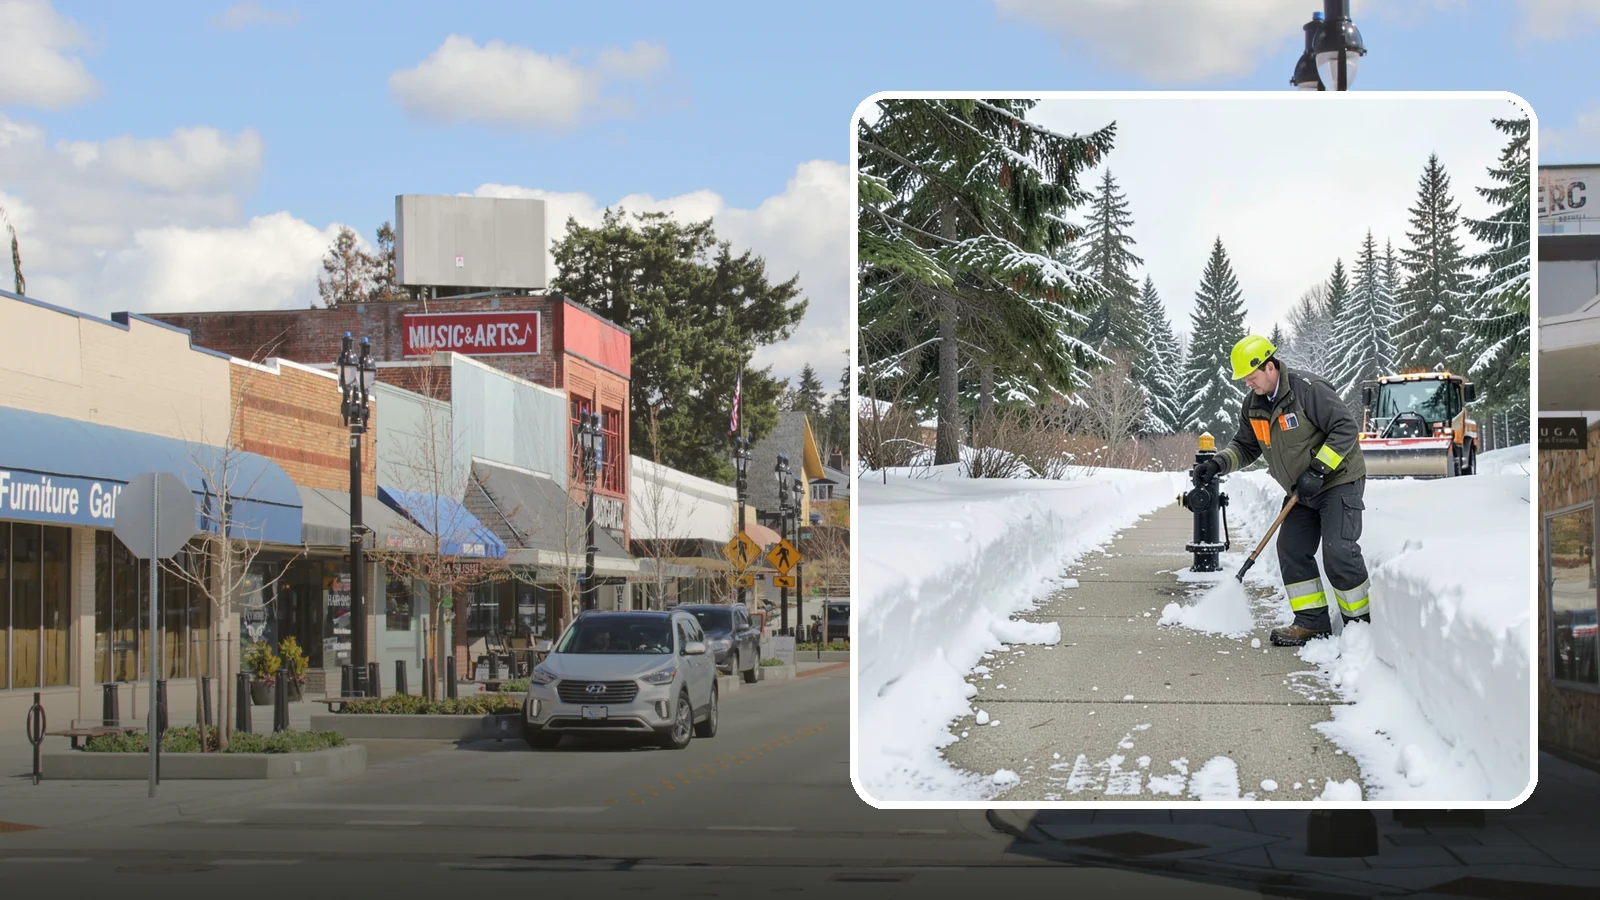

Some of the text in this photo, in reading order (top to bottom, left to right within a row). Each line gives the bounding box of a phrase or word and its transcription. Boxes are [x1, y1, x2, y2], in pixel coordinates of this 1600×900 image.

[409, 323, 519, 349] MUSIC&ARTS
[0, 472, 122, 519] Furniture Gal
[453, 563, 479, 574] SUSHI
[328, 594, 341, 606] HAIR
